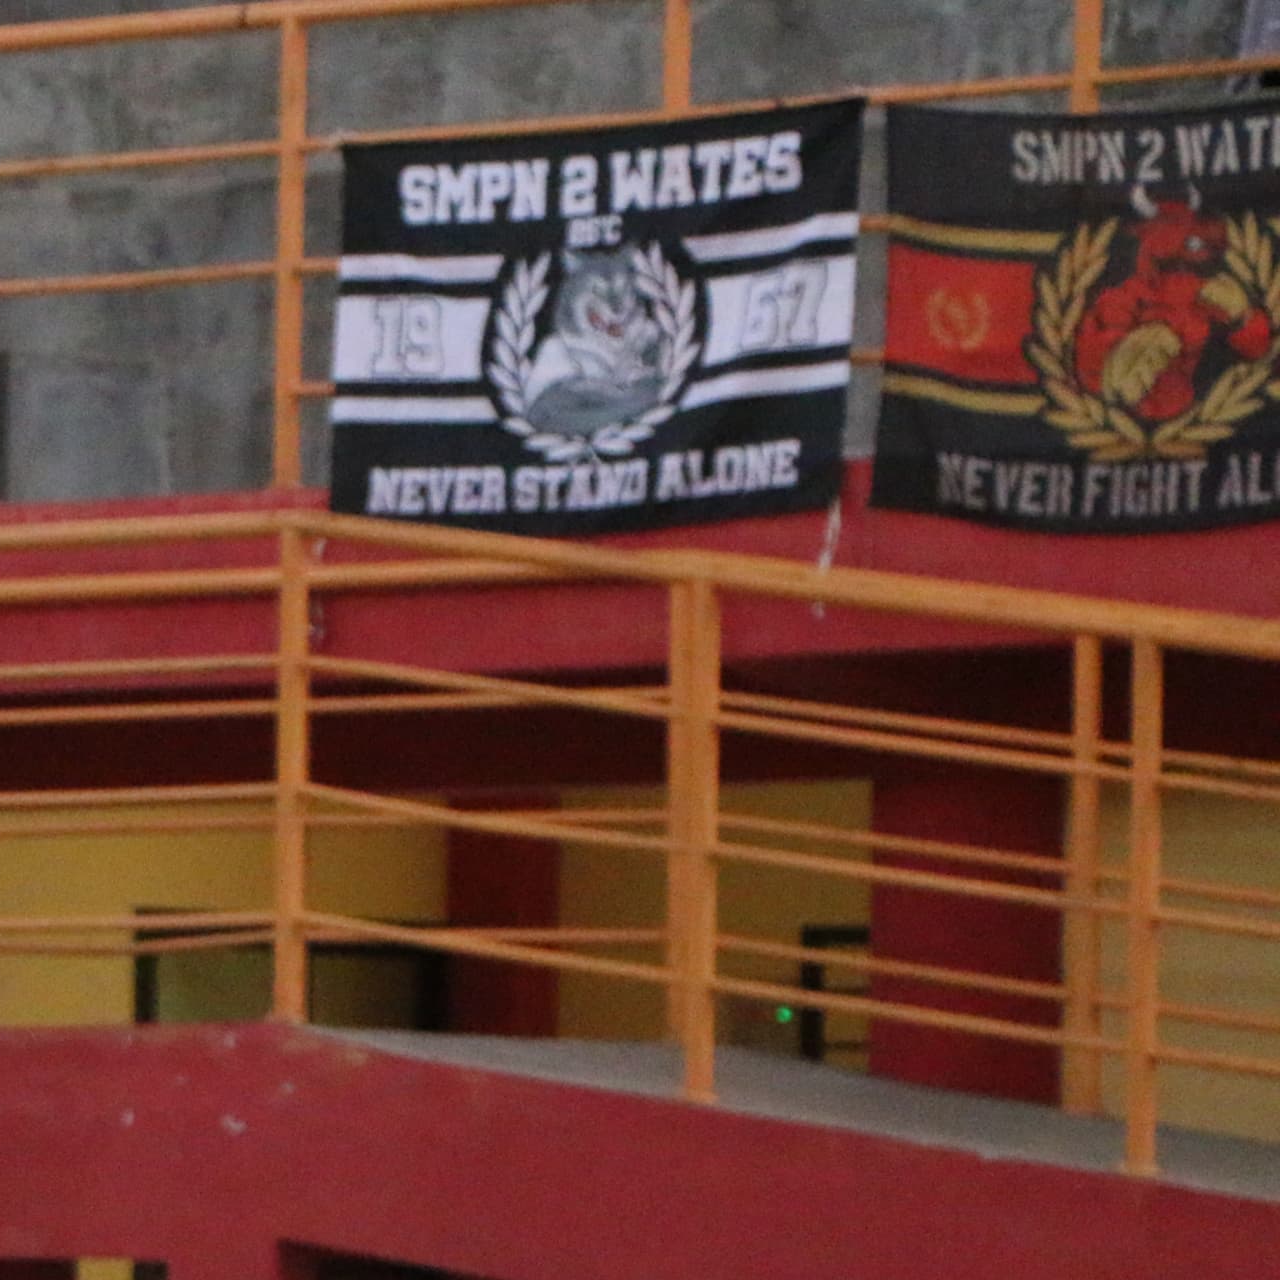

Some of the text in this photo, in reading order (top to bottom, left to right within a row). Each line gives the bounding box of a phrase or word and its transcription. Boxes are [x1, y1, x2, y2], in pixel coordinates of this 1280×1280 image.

[399, 130, 804, 227] SMPN 2 WATES
[1012, 129, 1127, 184] SMPN
[1138, 129, 1166, 182] 2
[371, 295, 445, 380] 19
[365, 437, 802, 516] NEVER STAND ALONE
[936, 451, 1073, 517] NEVER
[1081, 458, 1210, 520] FIGHT
